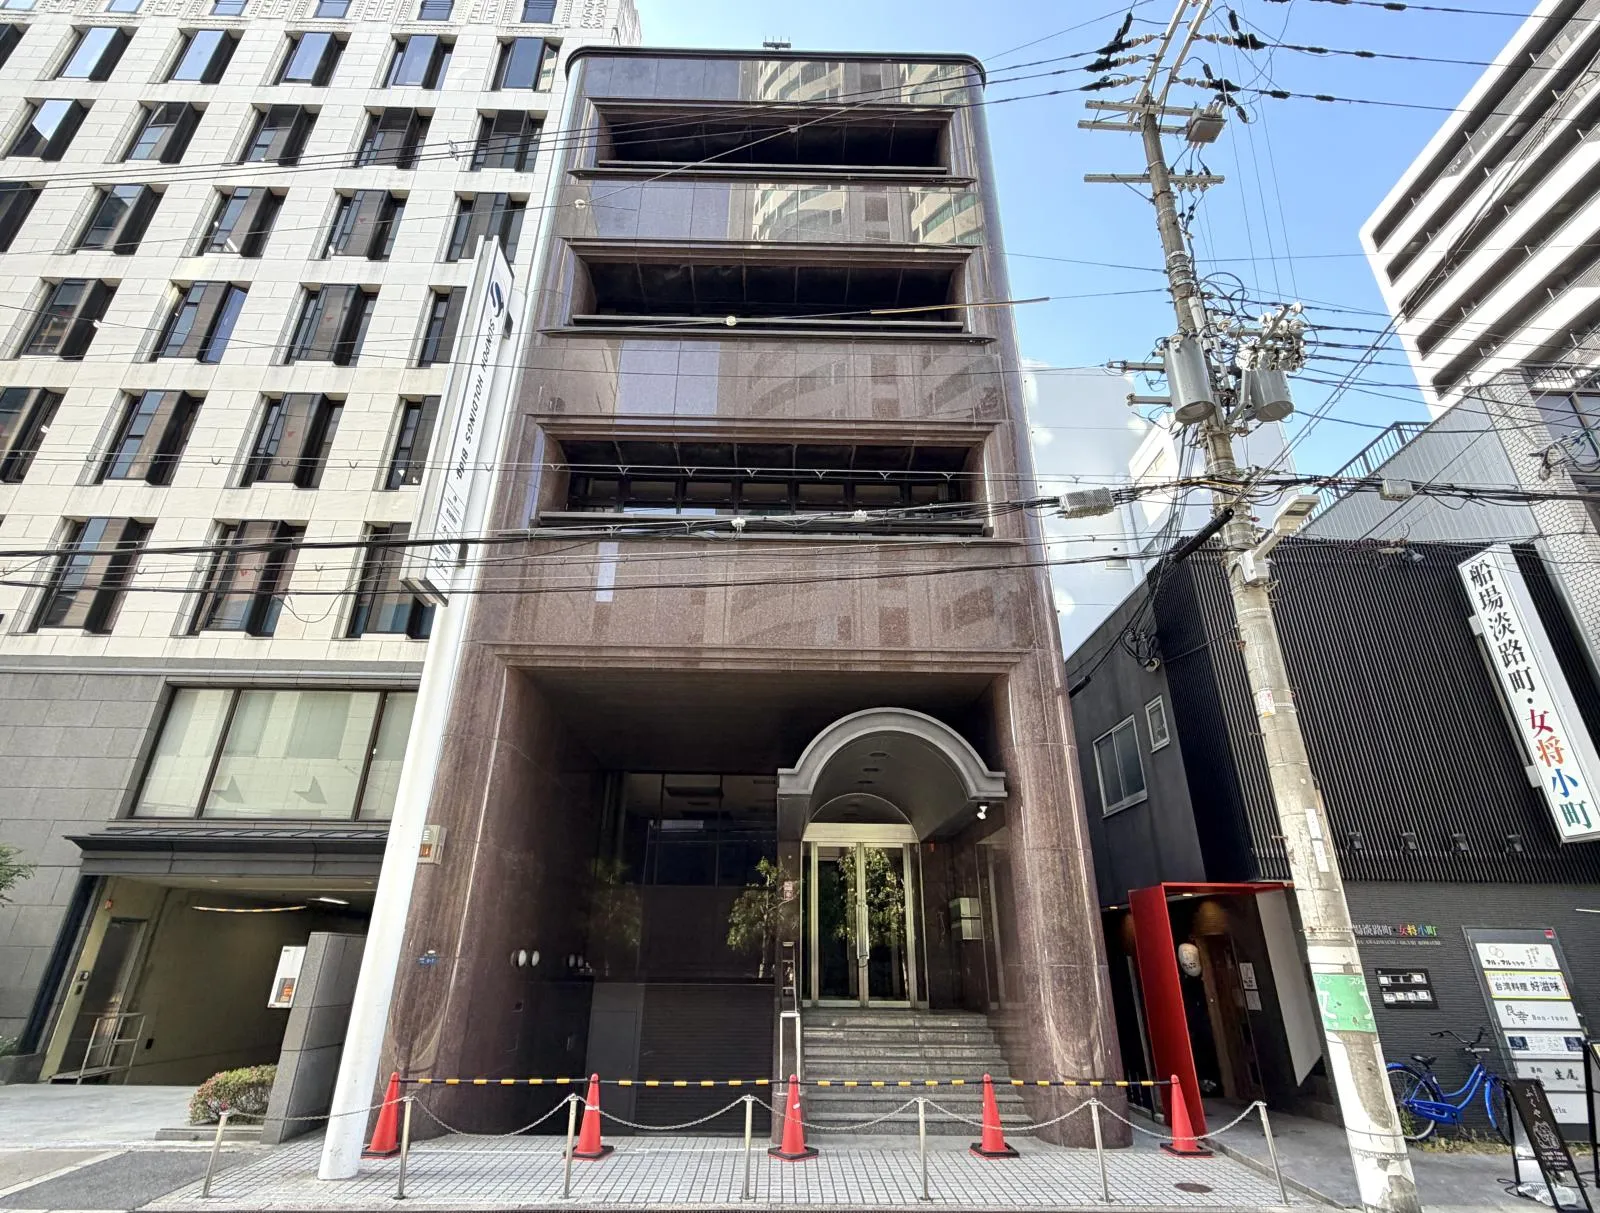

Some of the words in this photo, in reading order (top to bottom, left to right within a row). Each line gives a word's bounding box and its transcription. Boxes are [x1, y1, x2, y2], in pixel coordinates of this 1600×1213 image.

[465, 374, 485, 444] HOLDINGS
[456, 447, 469, 480] Bldg.
[1470, 560, 1593, 829] 船場淡路町・女将小町
[1495, 981, 1529, 992] 台湾料理
